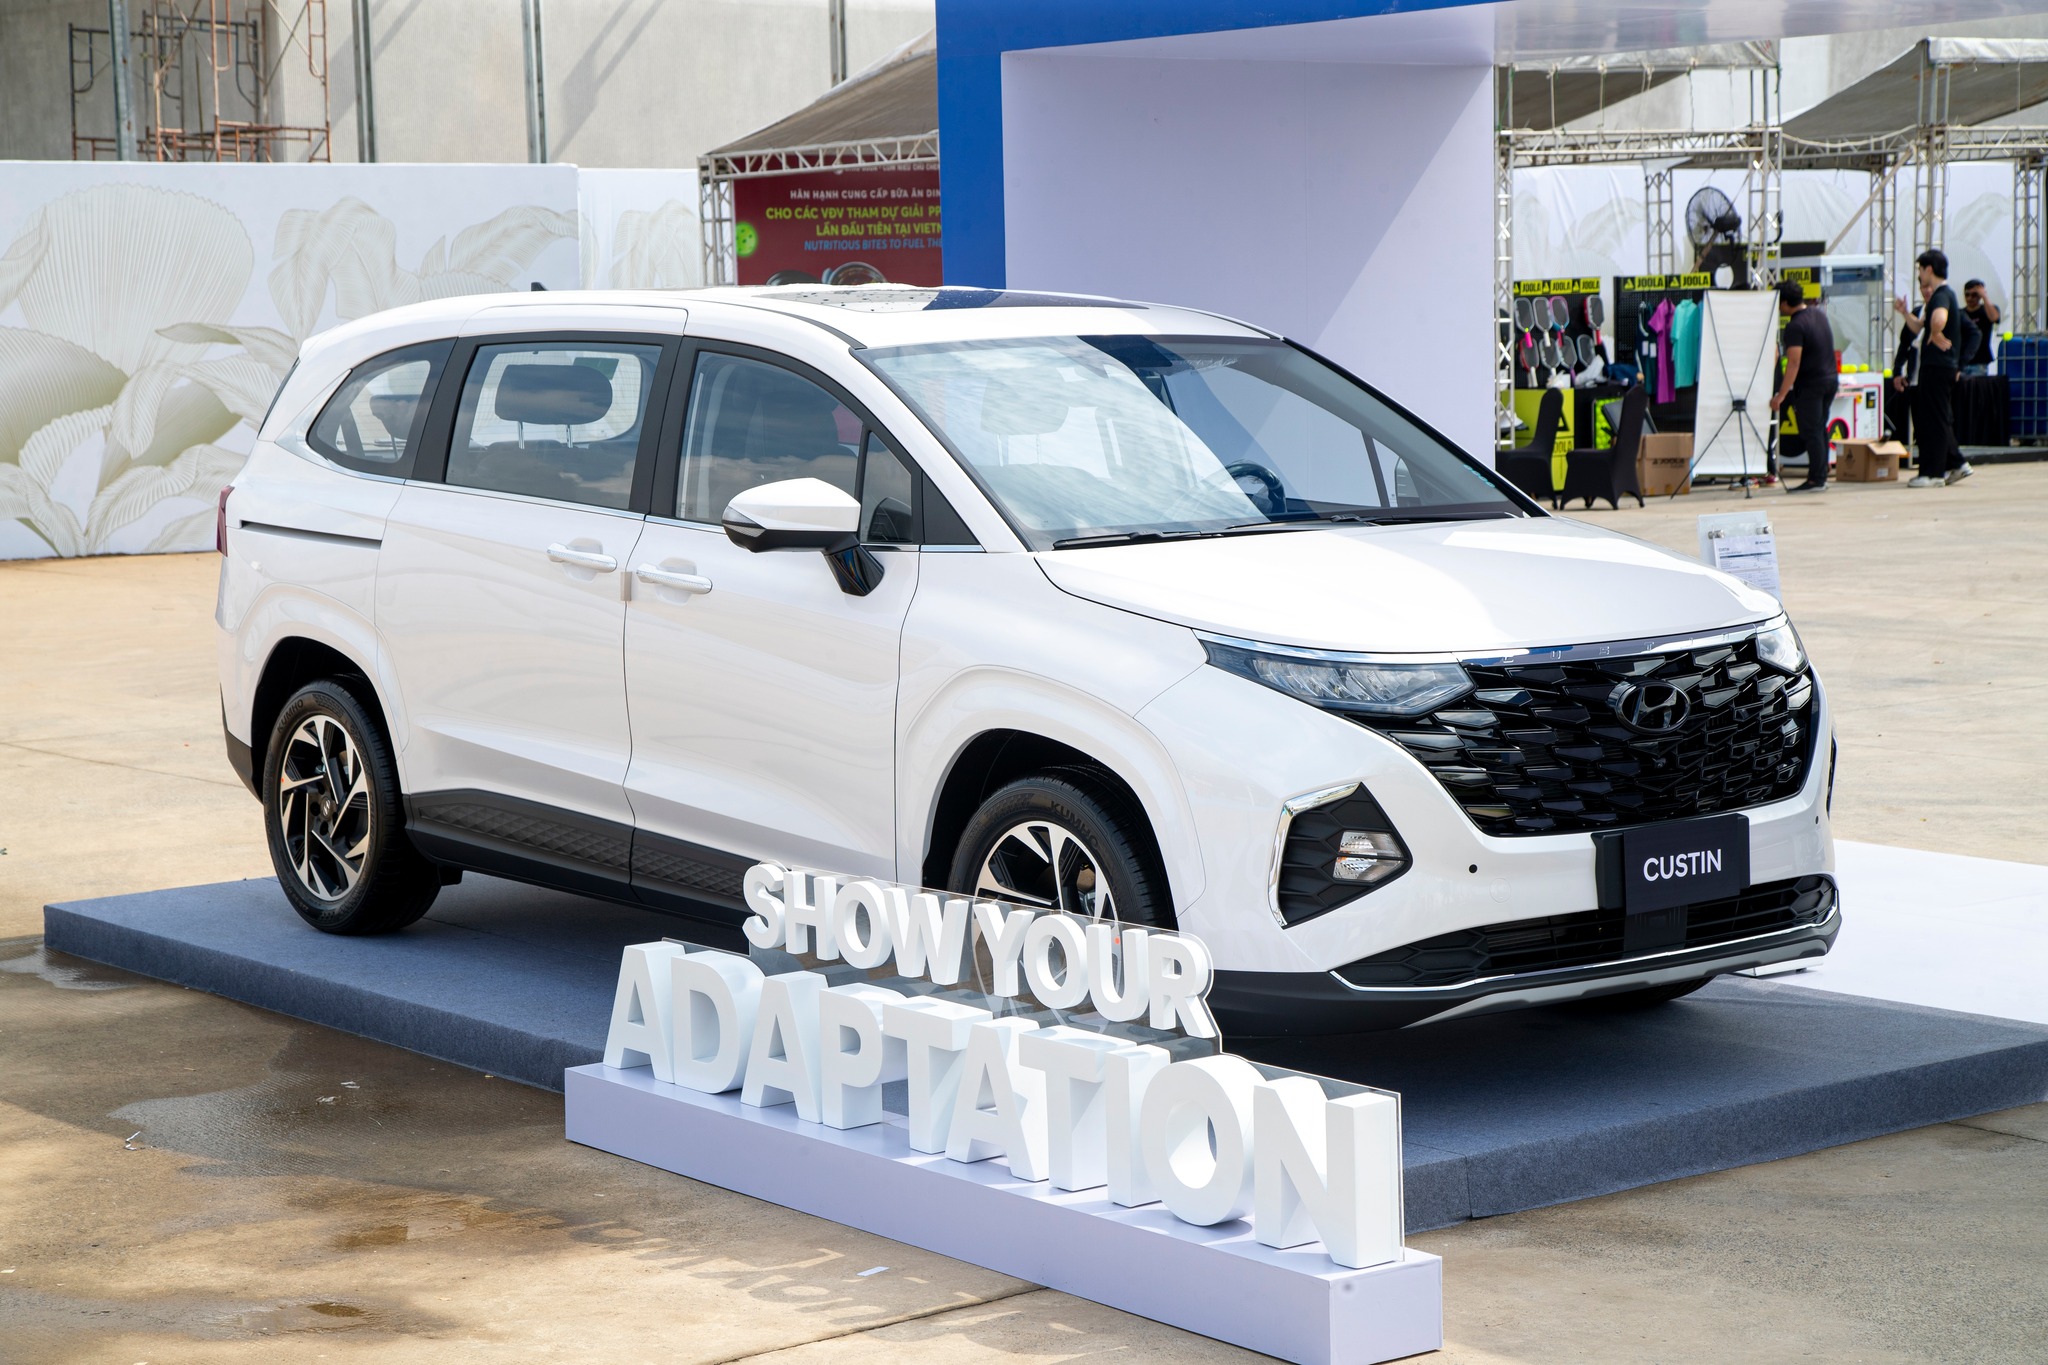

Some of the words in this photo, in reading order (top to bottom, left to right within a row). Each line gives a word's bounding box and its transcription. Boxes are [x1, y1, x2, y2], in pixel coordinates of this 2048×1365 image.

[841, 190, 867, 199] CUNG
[765, 207, 792, 219] CHO
[794, 204, 818, 219] CÁC
[820, 206, 844, 219] VĐV
[847, 206, 879, 218] THAM
[881, 205, 899, 221] DỰ
[901, 203, 923, 218] GIẢI
[867, 220, 892, 235] TIÊN
[894, 222, 911, 238] TẠI
[804, 239, 860, 251] NUTRITIOUS
[862, 239, 887, 250] BITES
[889, 238, 901, 249] TO
[903, 238, 924, 249] FUEL
[1522, 281, 1541, 293] JOOLA
[1552, 280, 1572, 291] JOOLA
[1637, 275, 1664, 287] JOOLA
[1683, 273, 1709, 286] JOOLA
[277, 699, 304, 734] KUMHO
[1643, 848, 1722, 882] CUSTIN
[743, 863, 968, 986] SHOW
[973, 903, 1217, 1038] YOUR
[603, 941, 1400, 1269] ADAPTATION
